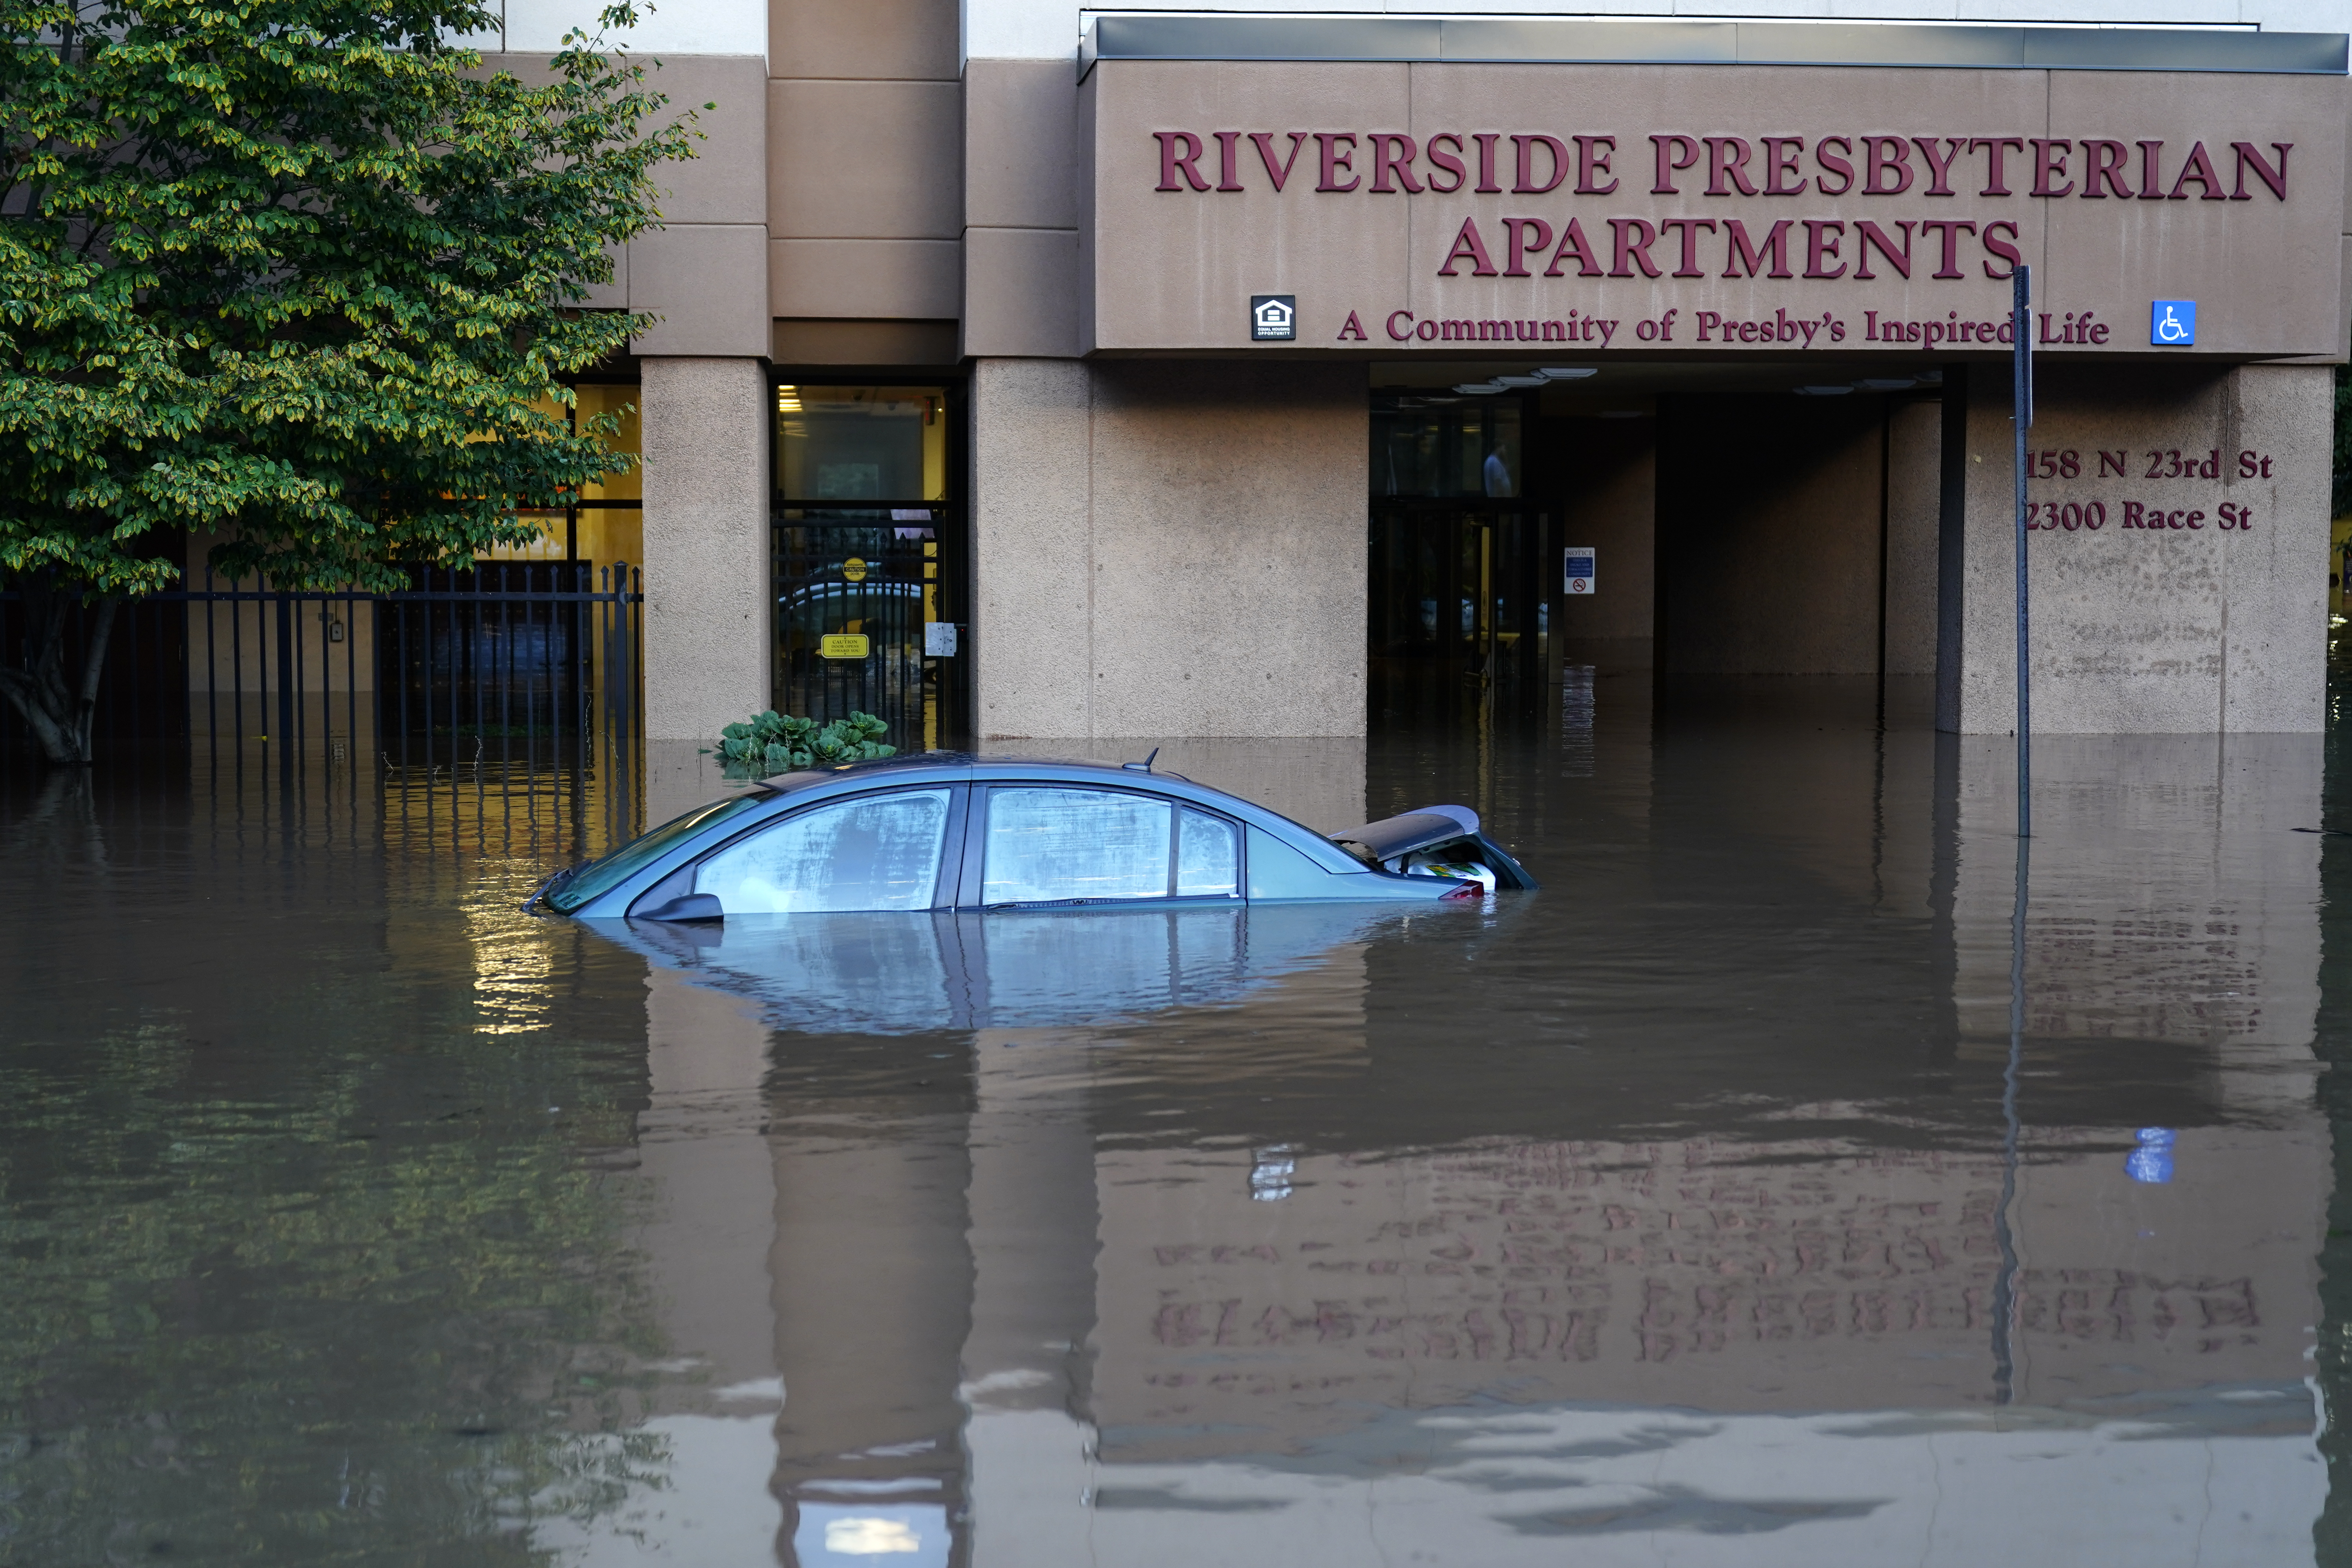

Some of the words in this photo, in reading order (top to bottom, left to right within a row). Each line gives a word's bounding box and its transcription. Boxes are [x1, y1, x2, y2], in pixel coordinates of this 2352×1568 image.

[1152, 131, 1619, 194] RIVERSIDE
[1649, 134, 2294, 201] PRESBYTERIAN
[1437, 216, 2021, 279] APARTMENTS
[1337, 310, 1368, 340] A
[1387, 309, 1619, 348] Community
[1636, 308, 1678, 341] of
[1696, 308, 1845, 348] Presby's
[1864, 310, 2015, 350] Inspired
[2039, 311, 2110, 344] Life
[2027, 450, 2081, 478] 158
[2098, 450, 2128, 478] N
[2145, 448, 2220, 478] 23rd
[2239, 450, 2273, 478] St
[2027, 501, 2106, 531] 2300
[2121, 500, 2205, 529] Race
[2218, 502, 2252, 530] St
